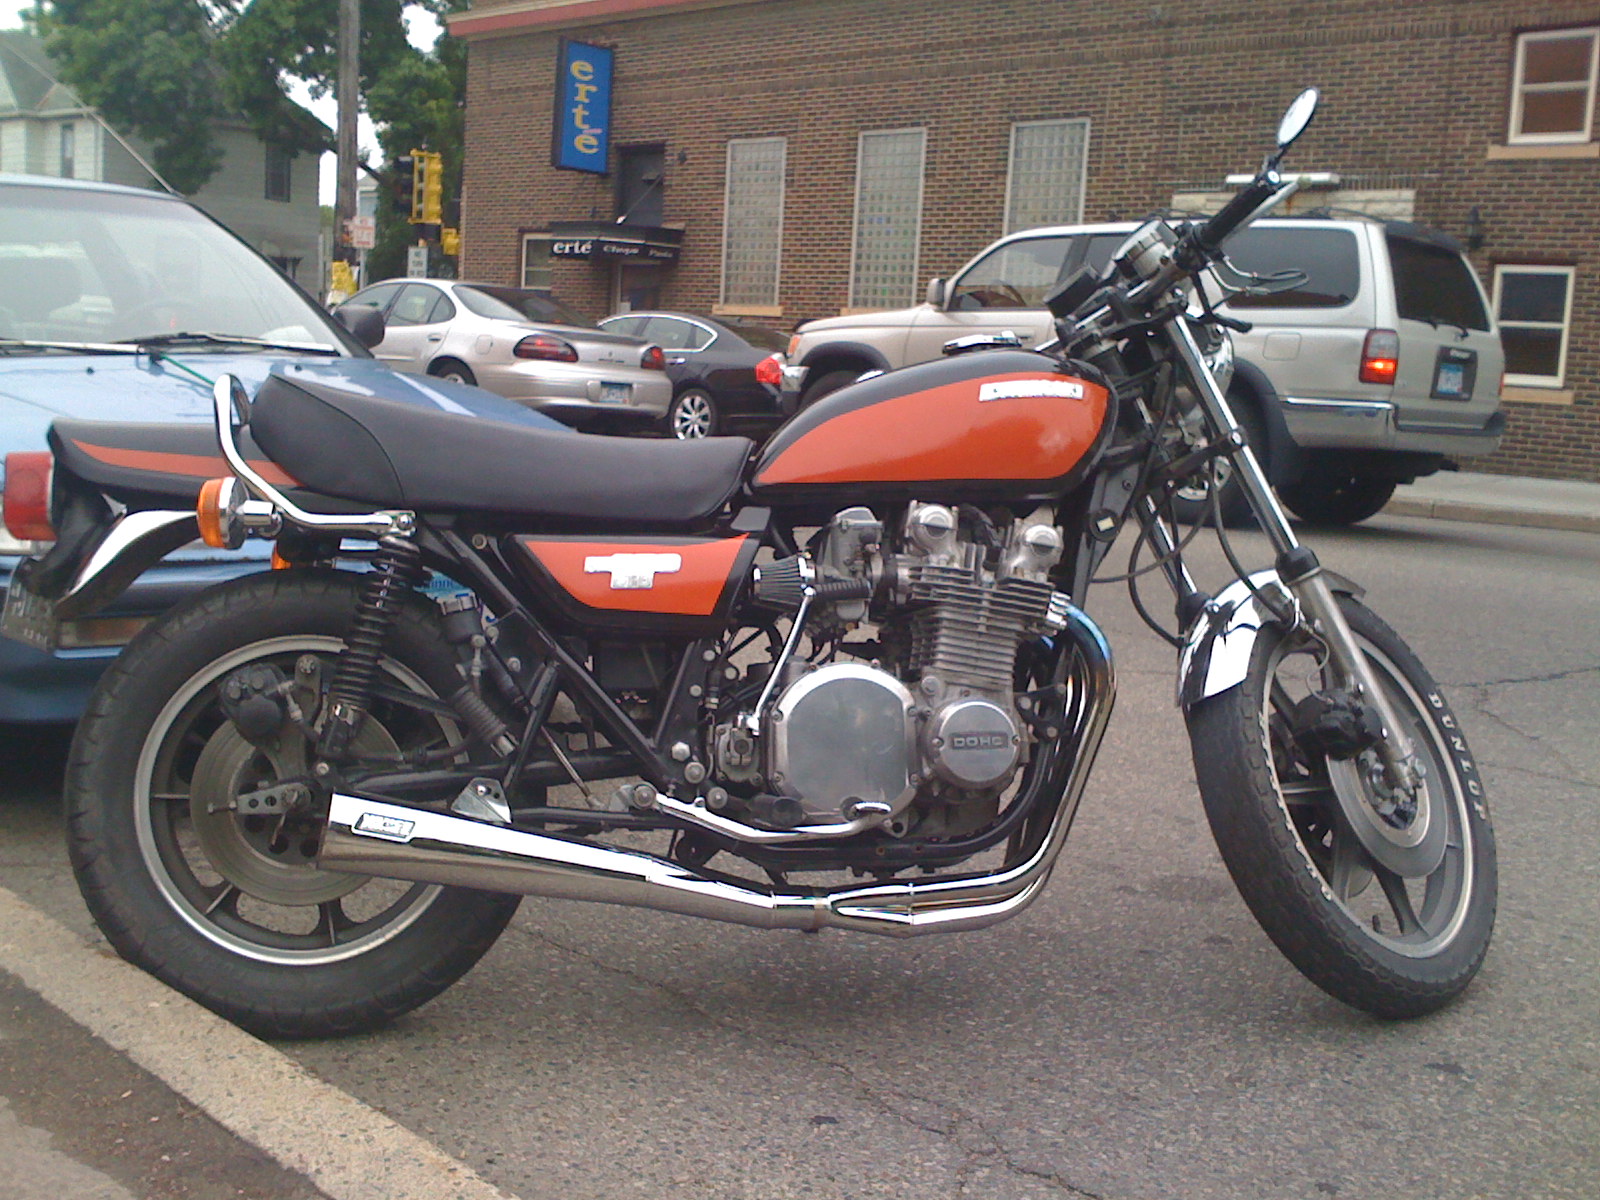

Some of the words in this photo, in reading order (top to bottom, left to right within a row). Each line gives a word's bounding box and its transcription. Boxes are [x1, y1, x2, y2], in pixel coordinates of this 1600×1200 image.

[570, 60, 602, 154] erté
[552, 240, 593, 254] erté
[953, 735, 1003, 748] DOHC
[1428, 692, 1486, 820] DUNLOP
